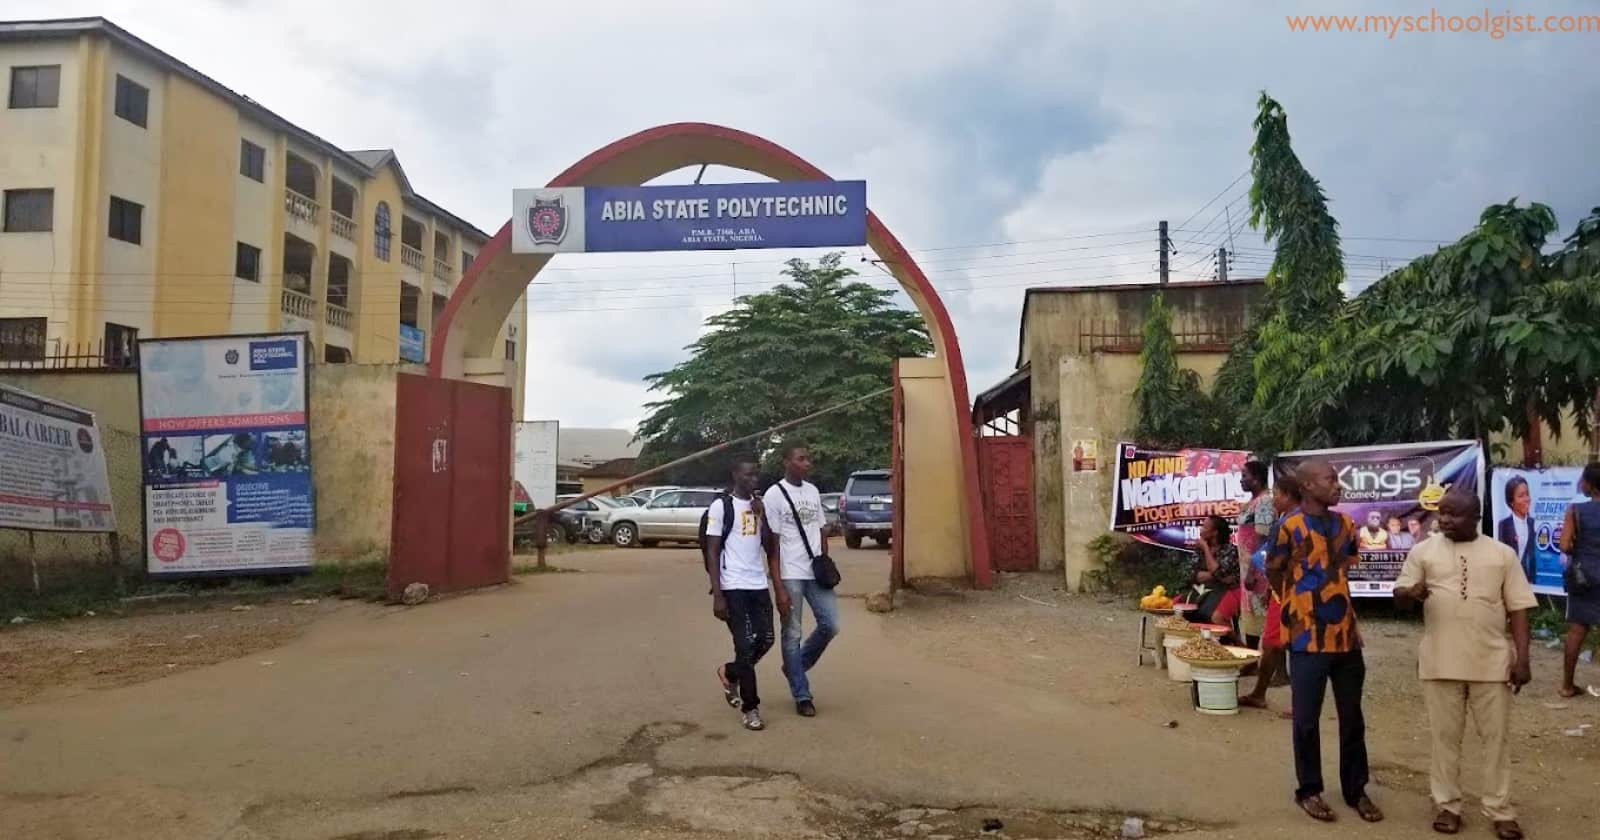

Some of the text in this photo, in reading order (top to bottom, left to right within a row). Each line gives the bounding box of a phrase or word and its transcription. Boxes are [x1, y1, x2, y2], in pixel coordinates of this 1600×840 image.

[602, 195, 848, 222] ABIA STATE POLYTECHNIC
[25, 419, 73, 447] CAREER
[159, 414, 291, 430] NOW OFFERS ADMISSIONS
[1128, 457, 1186, 479] ND/HND
[1121, 469, 1253, 511] Marketing
[1333, 465, 1422, 497] Kings
[1344, 490, 1380, 501] Comedy
[1134, 501, 1240, 523] Programmes
[1369, 553, 1389, 561] 2018
